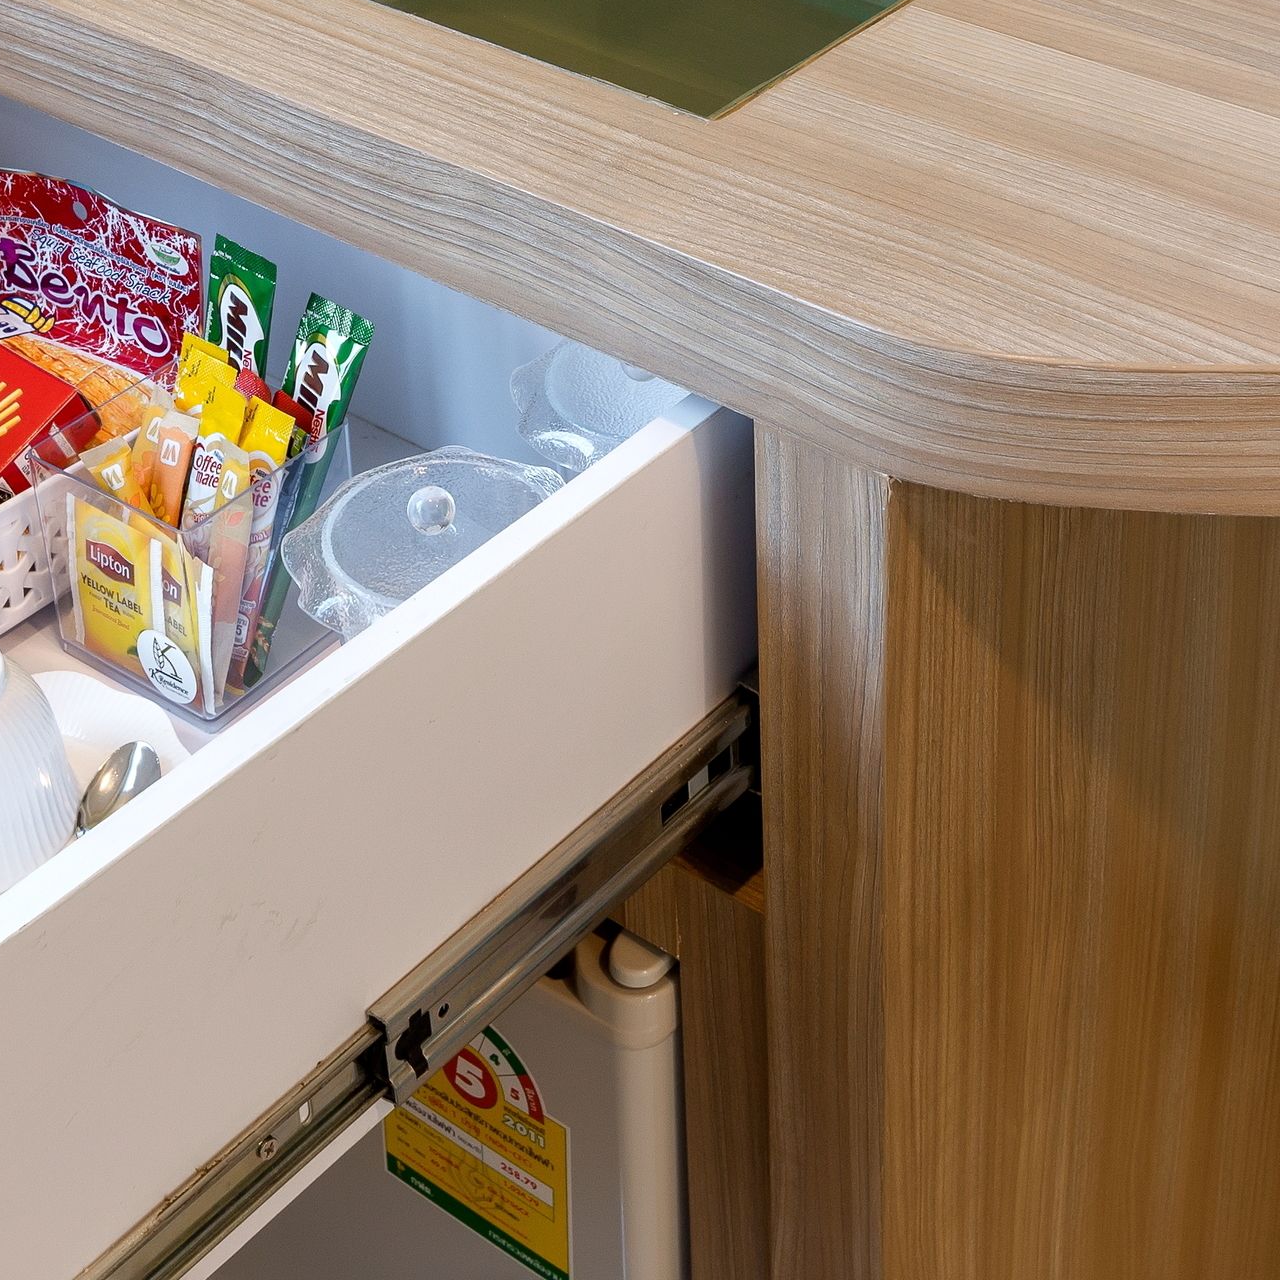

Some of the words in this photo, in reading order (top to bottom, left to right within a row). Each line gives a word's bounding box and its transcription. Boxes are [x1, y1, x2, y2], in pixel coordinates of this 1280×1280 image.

[30, 228, 66, 254] Squid
[69, 247, 124, 281] Seafood
[125, 273, 172, 305] Snack
[90, 544, 130, 580] Lipton
[81, 572, 115, 600] YELLOW
[116, 592, 143, 616] LABEL
[103, 598, 121, 615] TEA
[167, 616, 188, 638] ABEL
[455, 1056, 486, 1099] 5
[510, 1087, 520, 1101] 5
[503, 1113, 546, 1148] 2011
[500, 1162, 538, 1190] 258.79
